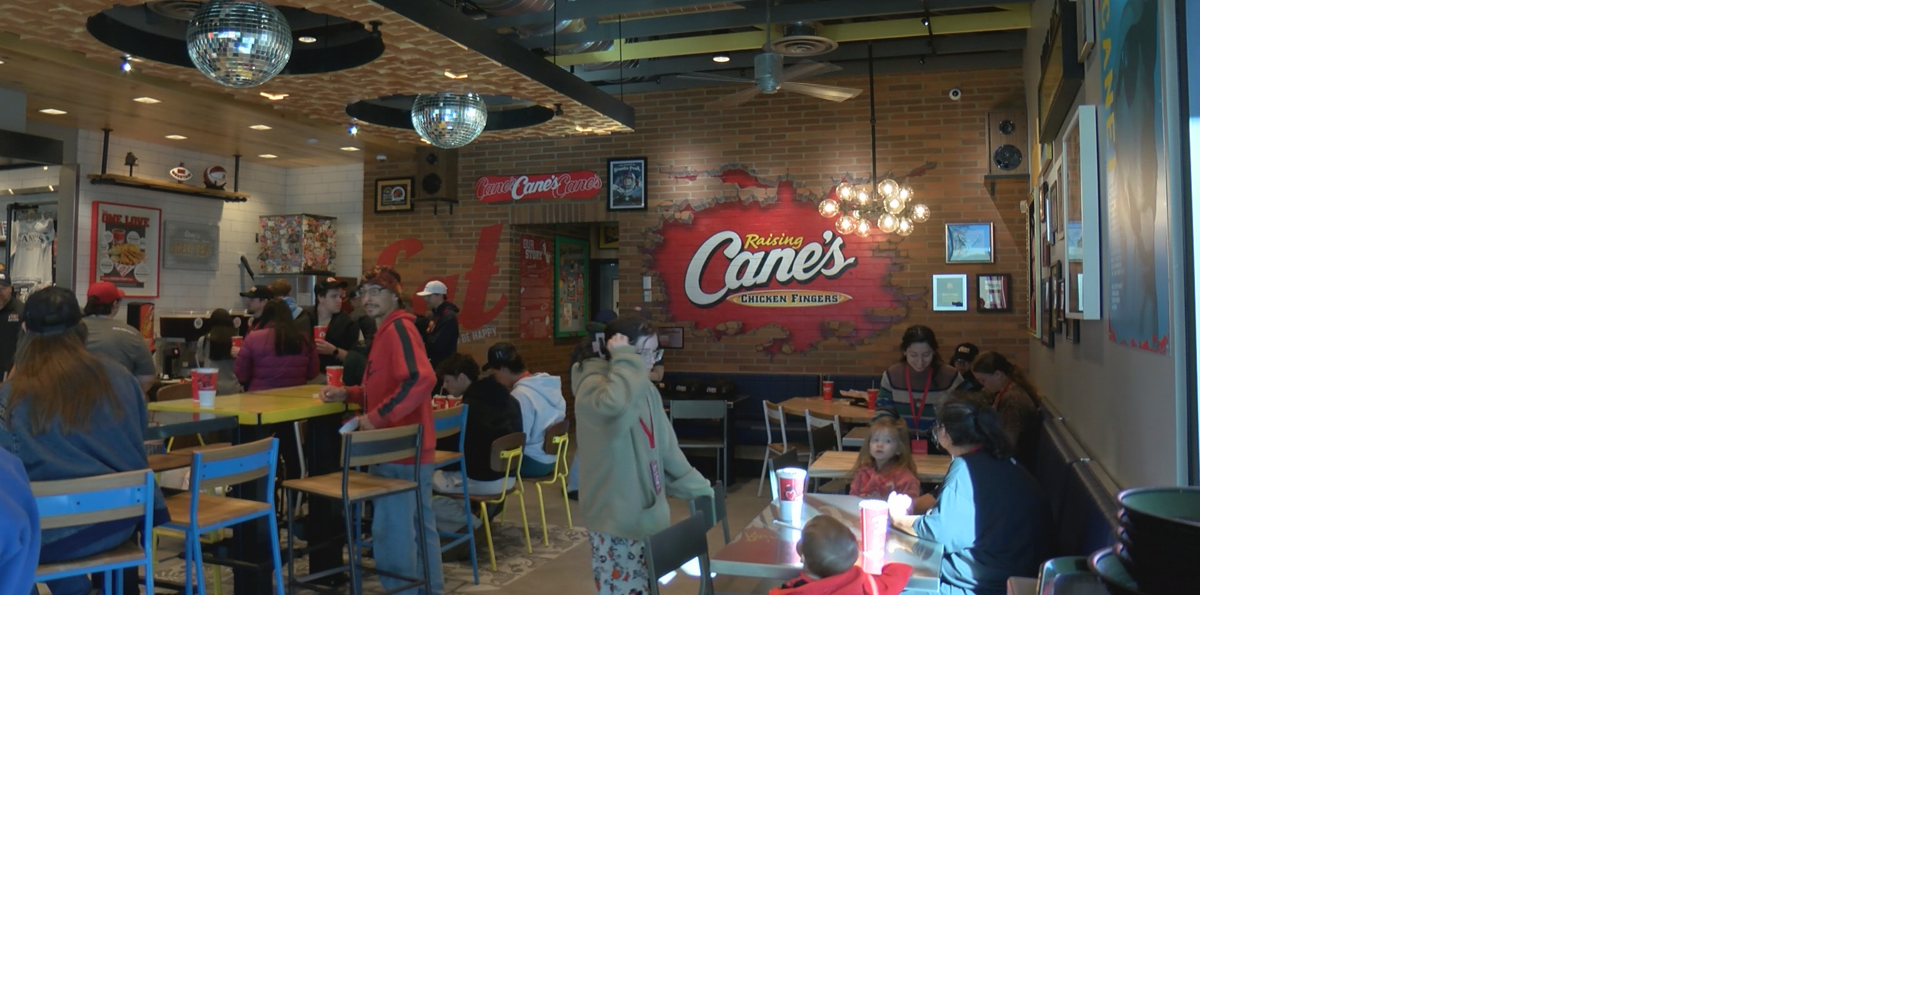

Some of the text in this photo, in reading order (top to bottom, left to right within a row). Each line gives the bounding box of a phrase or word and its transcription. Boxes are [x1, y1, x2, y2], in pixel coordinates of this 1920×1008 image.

[511, 175, 561, 199] Cane's
[102, 213, 150, 227] ONE LOVE
[523, 238, 534, 249] OUR
[744, 233, 803, 250] Raising
[525, 249, 543, 260] STORY
[684, 230, 857, 307] Cane's
[741, 294, 838, 303] CHICKEN FINGERS
[461, 332, 471, 343] BE
[472, 326, 497, 341] HAPPY
